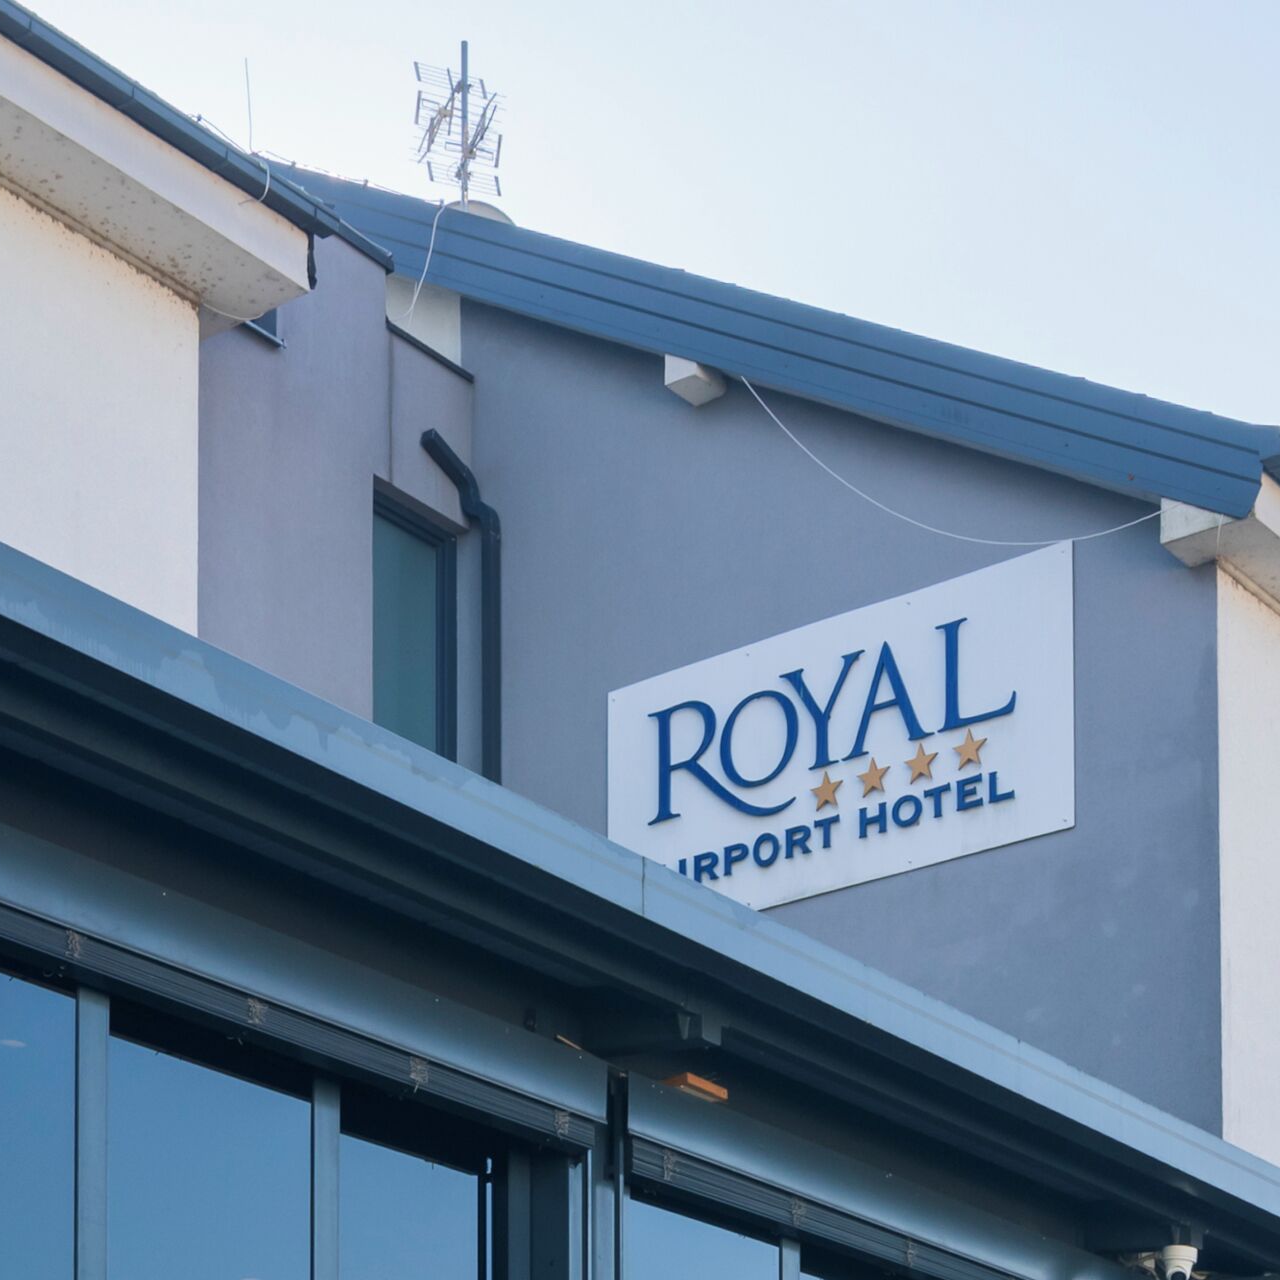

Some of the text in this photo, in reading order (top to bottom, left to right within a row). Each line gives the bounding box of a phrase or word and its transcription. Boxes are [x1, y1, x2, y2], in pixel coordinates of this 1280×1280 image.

[648, 617, 1016, 825] ROYAL
[678, 772, 1015, 883] IRPORT HOTEL
